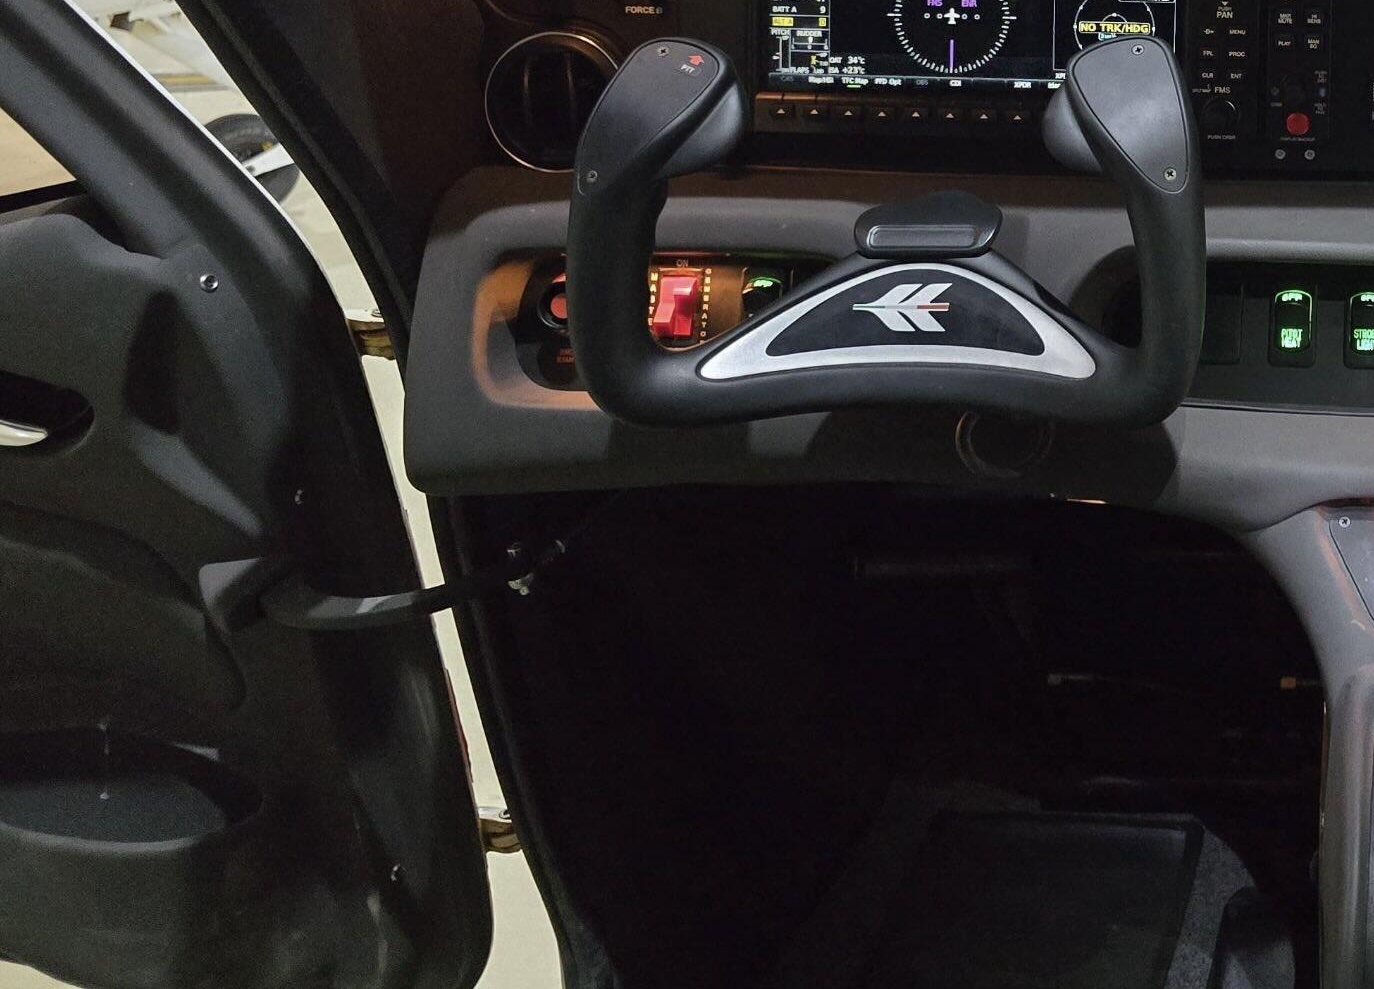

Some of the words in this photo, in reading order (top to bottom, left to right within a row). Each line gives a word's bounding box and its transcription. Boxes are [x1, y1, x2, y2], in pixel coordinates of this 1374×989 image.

[625, 6, 654, 14] FORCE
[1216, 11, 1233, 19] PAN
[1080, 23, 1096, 31] NO
[1101, 24, 1149, 33] TRK/HDG
